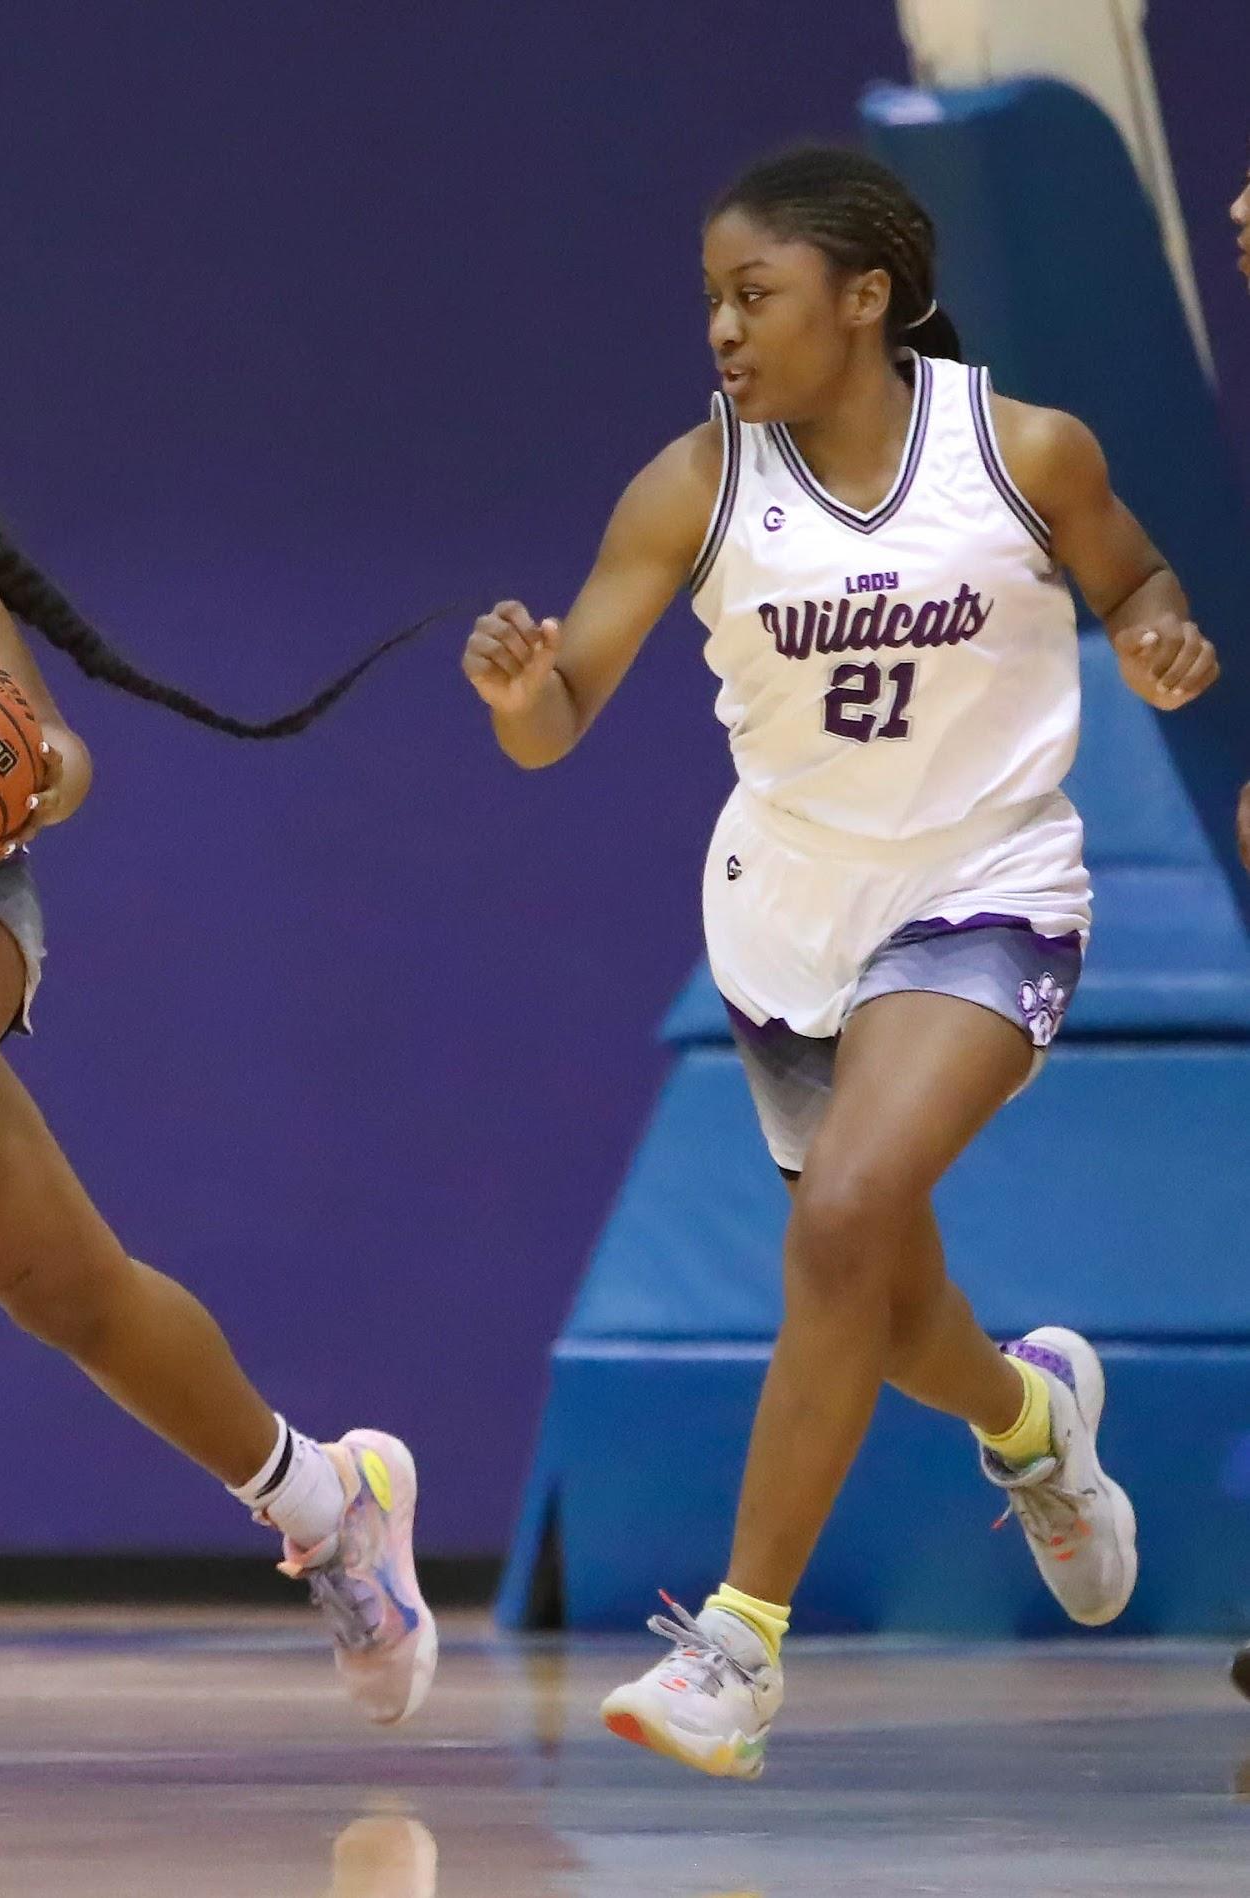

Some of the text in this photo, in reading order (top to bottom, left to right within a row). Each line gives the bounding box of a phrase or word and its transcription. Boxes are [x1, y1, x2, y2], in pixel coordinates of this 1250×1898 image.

[845, 571, 899, 594] LADY
[758, 583, 994, 660] Wildcats
[821, 661, 917, 743] 21
